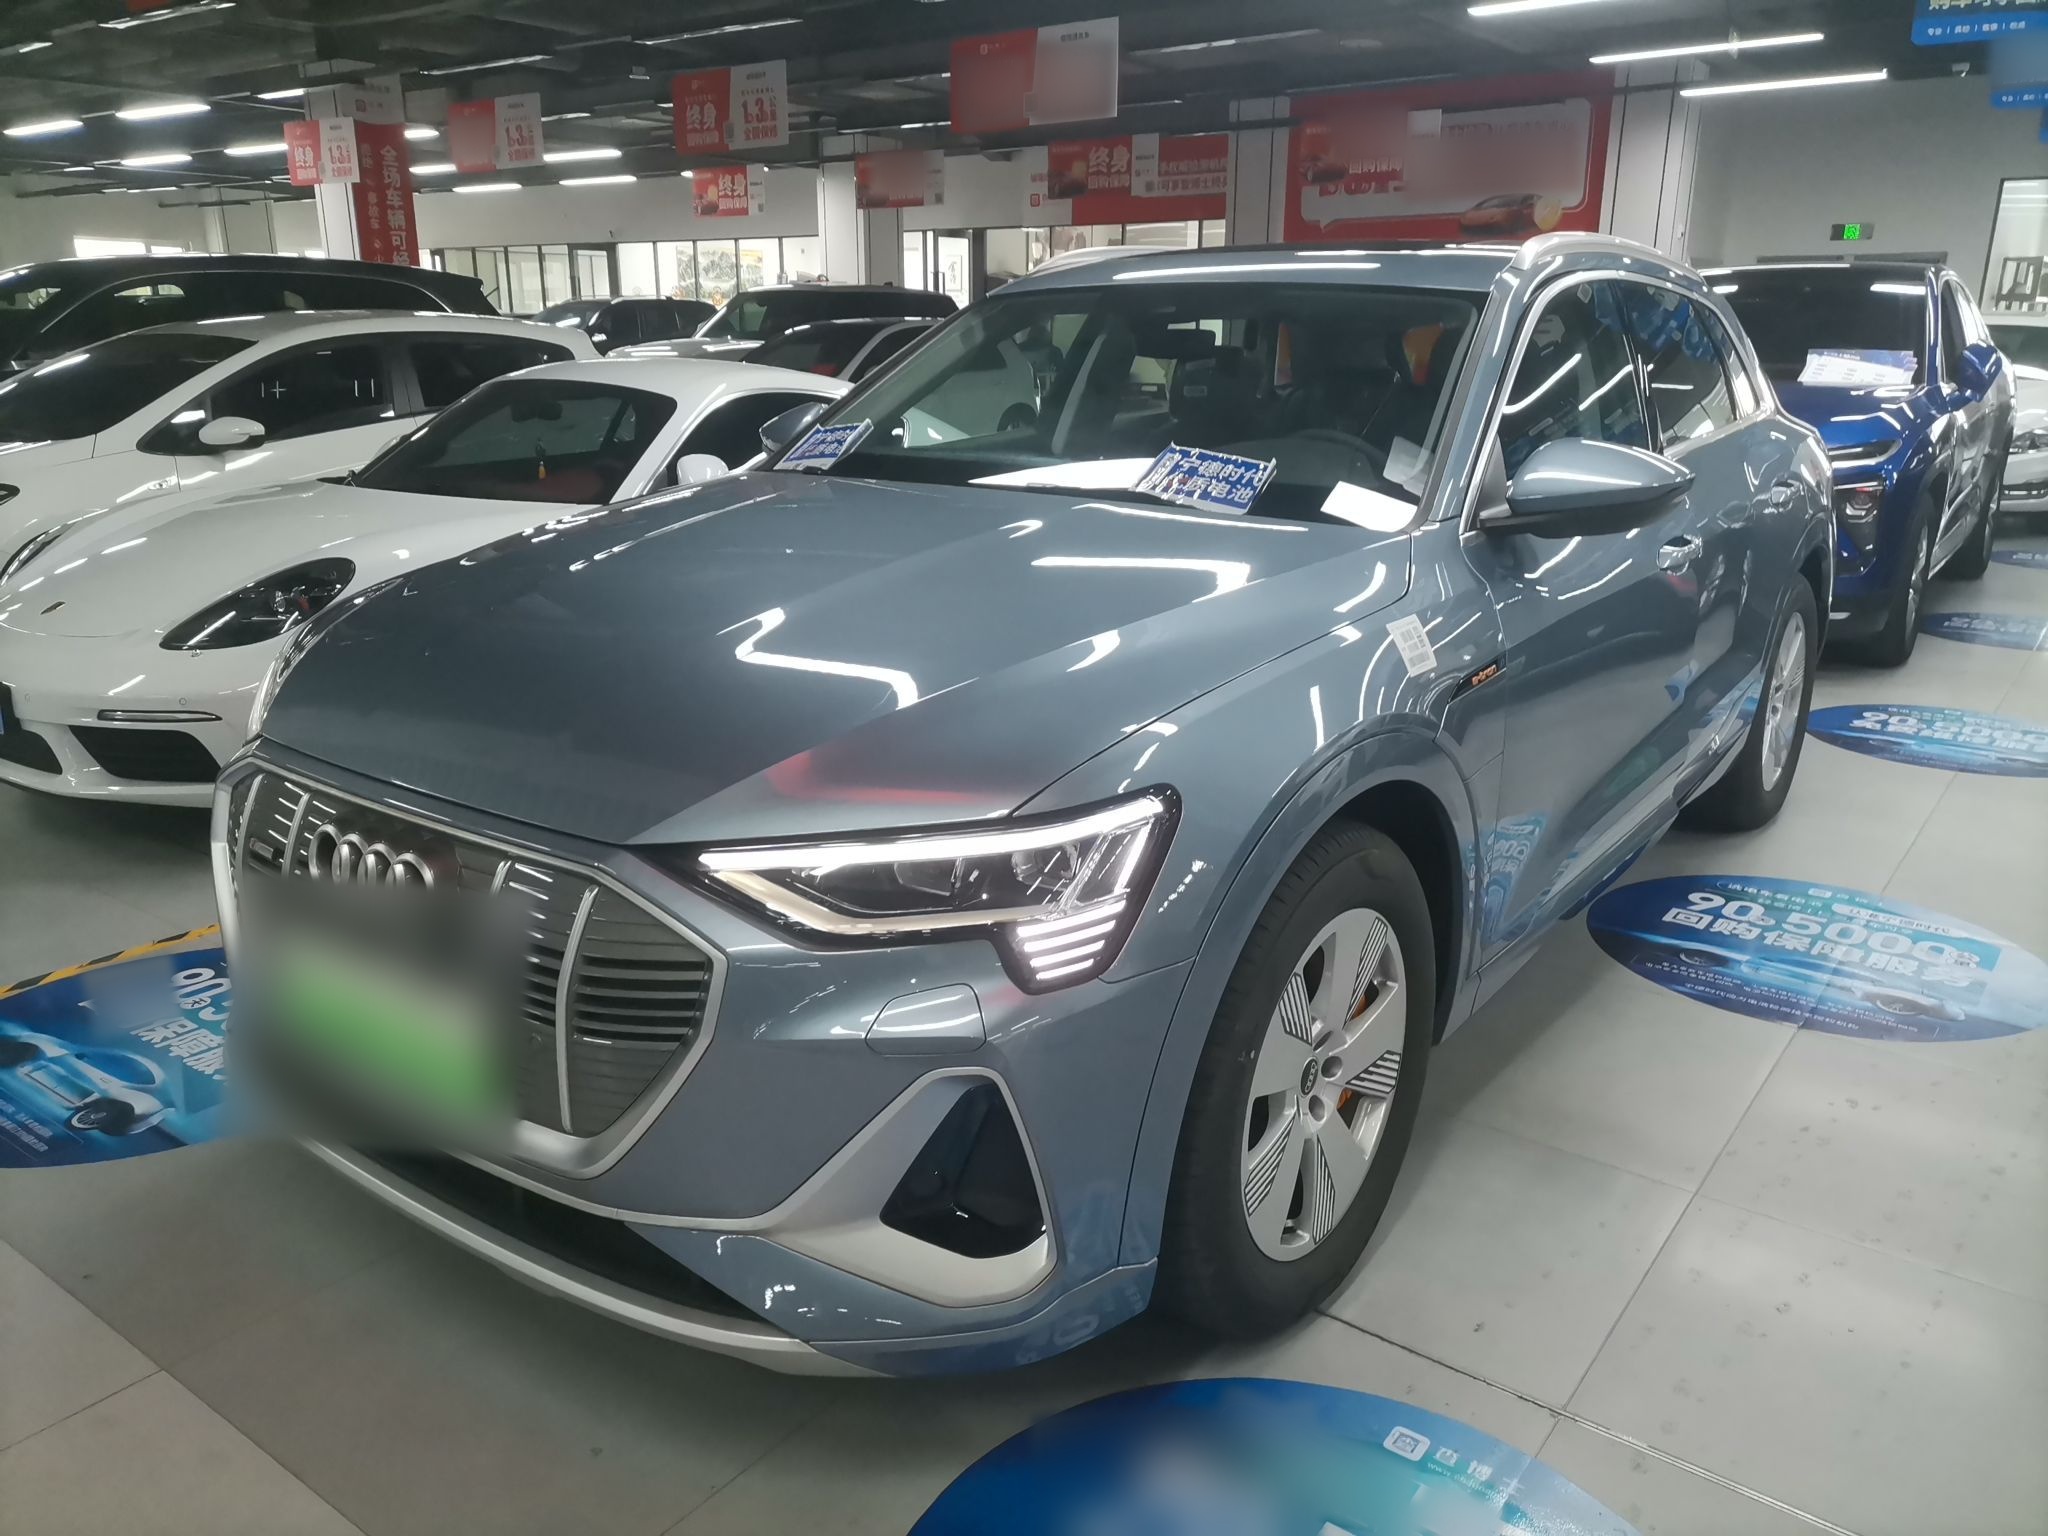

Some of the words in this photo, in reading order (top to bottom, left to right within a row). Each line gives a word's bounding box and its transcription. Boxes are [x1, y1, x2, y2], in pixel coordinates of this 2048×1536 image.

[1088, 143, 1130, 174] 终身
[718, 172, 746, 196] 终身
[1178, 451, 1265, 486] 宁德时代
[1661, 908, 1976, 988] 回购保障服务
